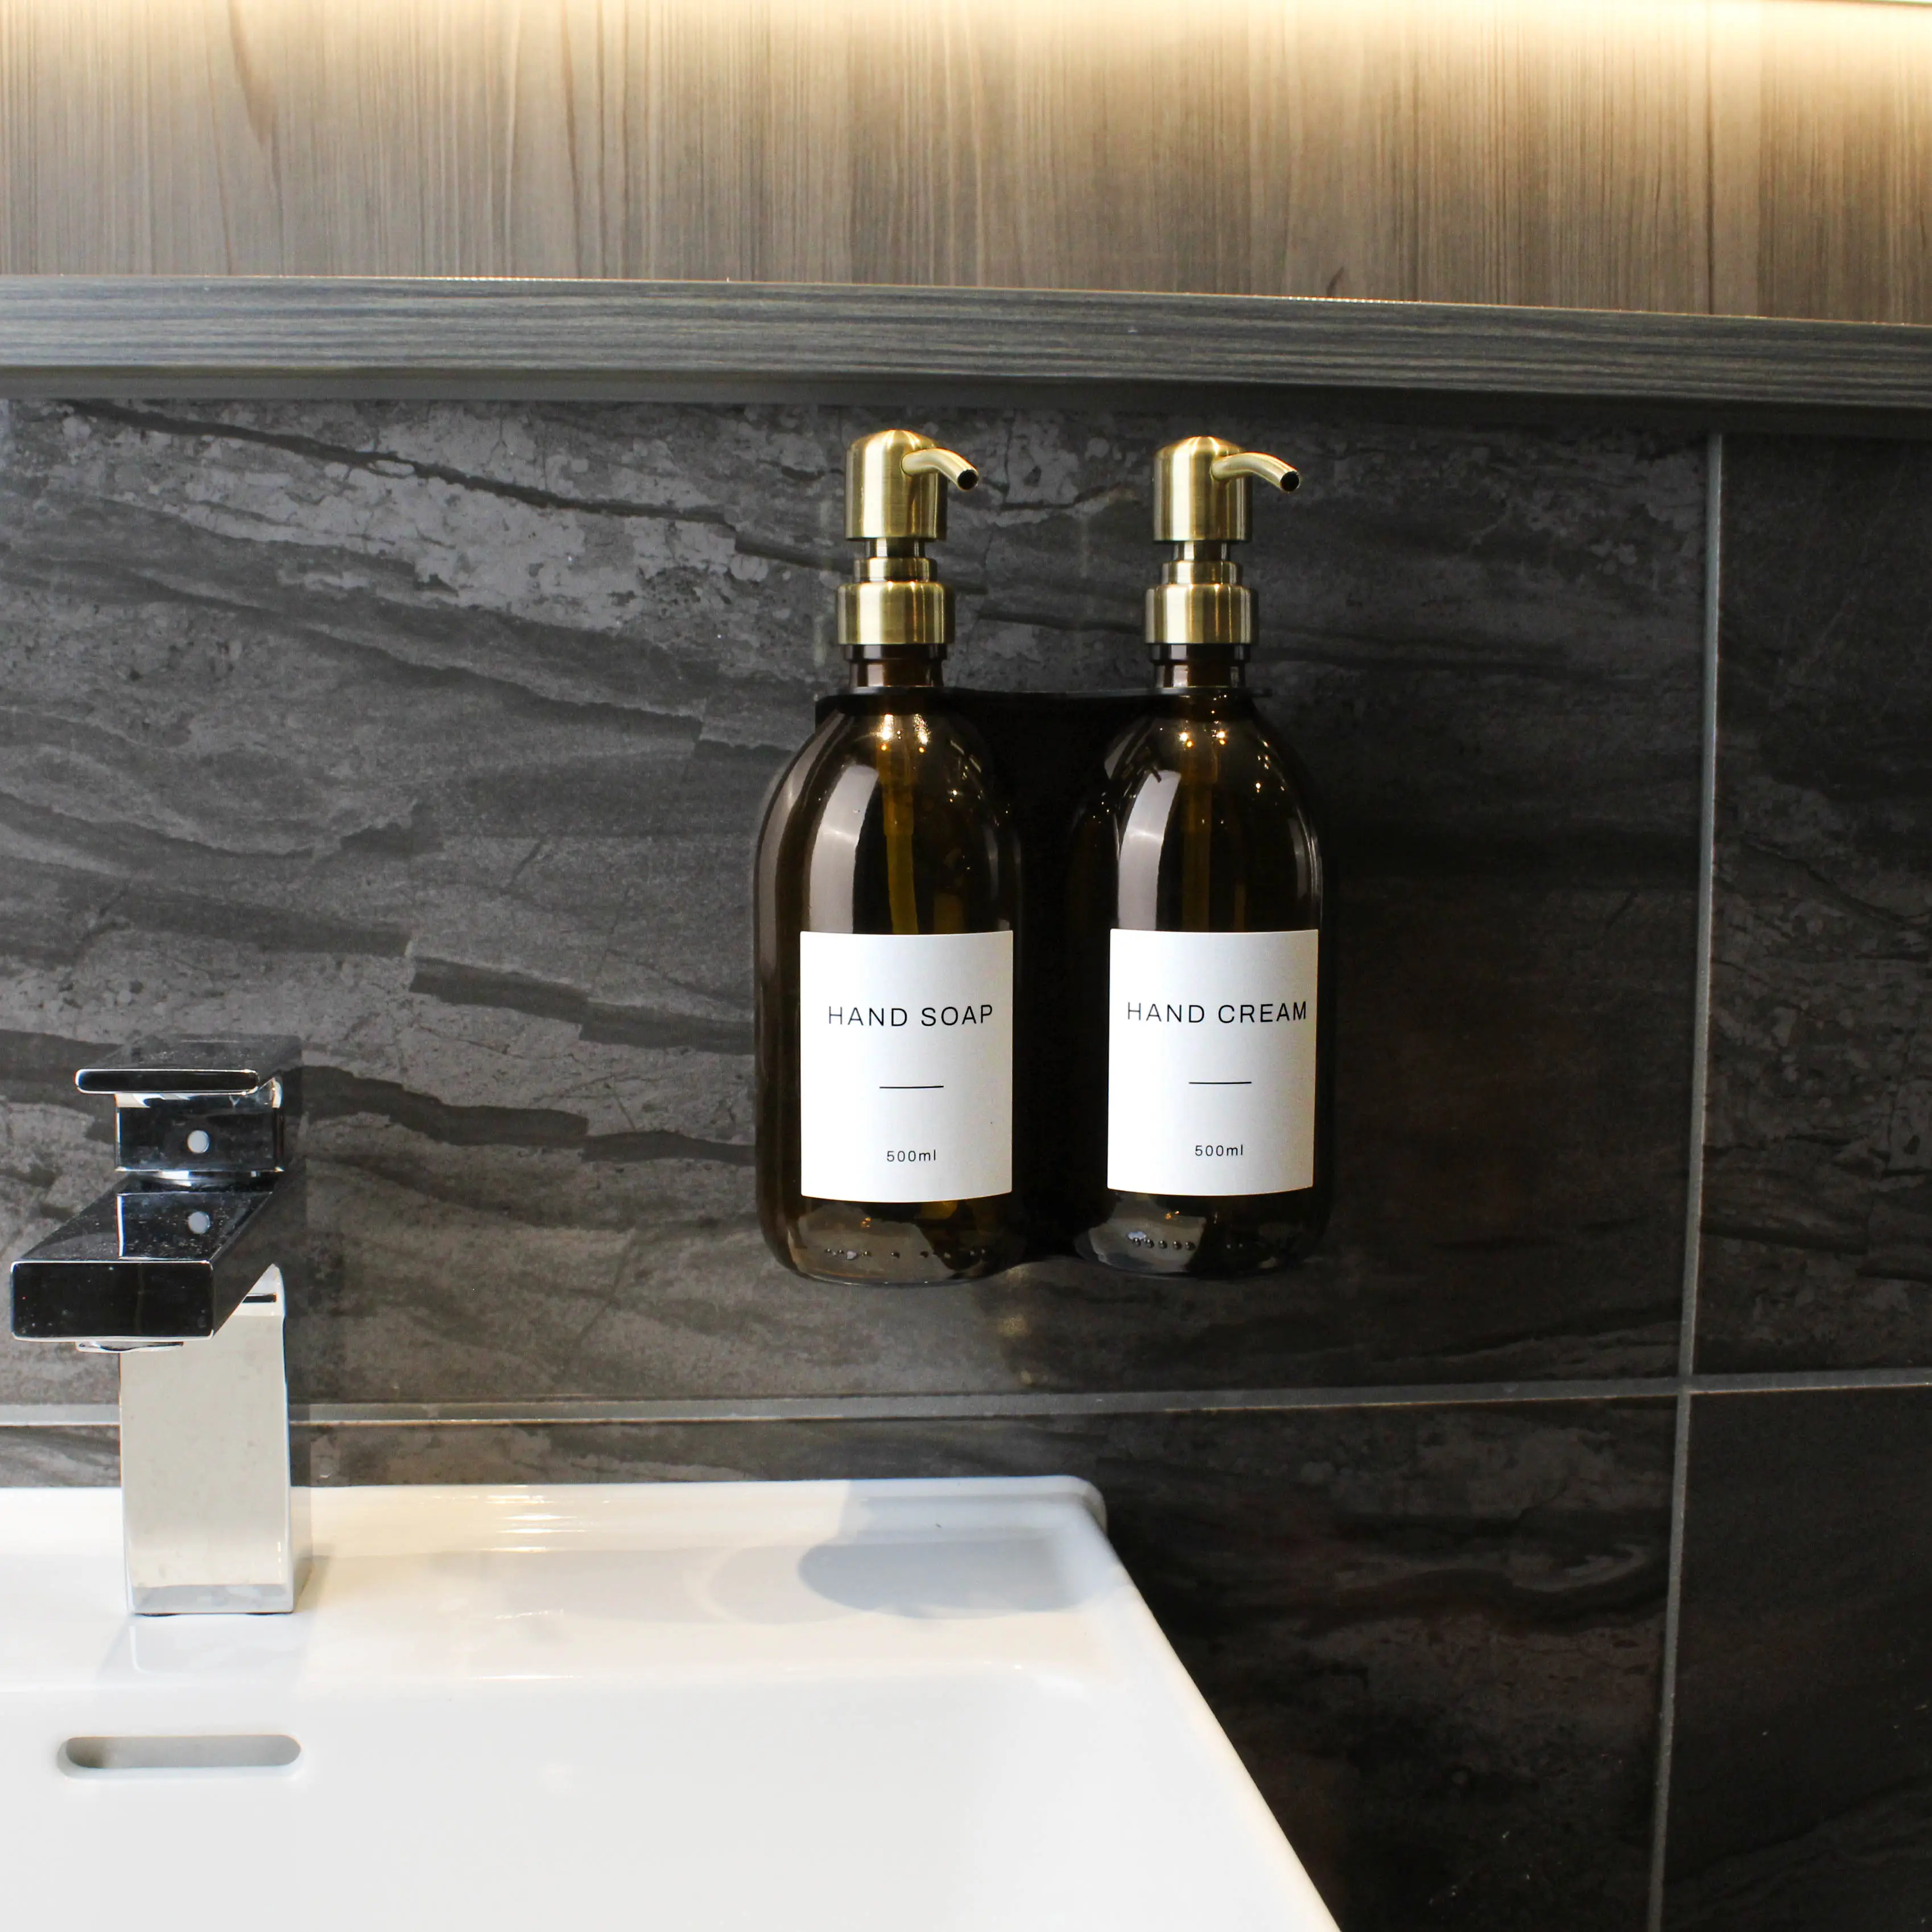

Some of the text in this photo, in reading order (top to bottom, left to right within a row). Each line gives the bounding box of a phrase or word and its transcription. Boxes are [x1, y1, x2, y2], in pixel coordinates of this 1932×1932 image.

[829, 1004, 993, 1027] HAND SOAP
[1128, 1001, 1307, 1023] HAND CREAM
[887, 1149, 936, 1162] 500ml
[1195, 1144, 1244, 1157] 500ml
